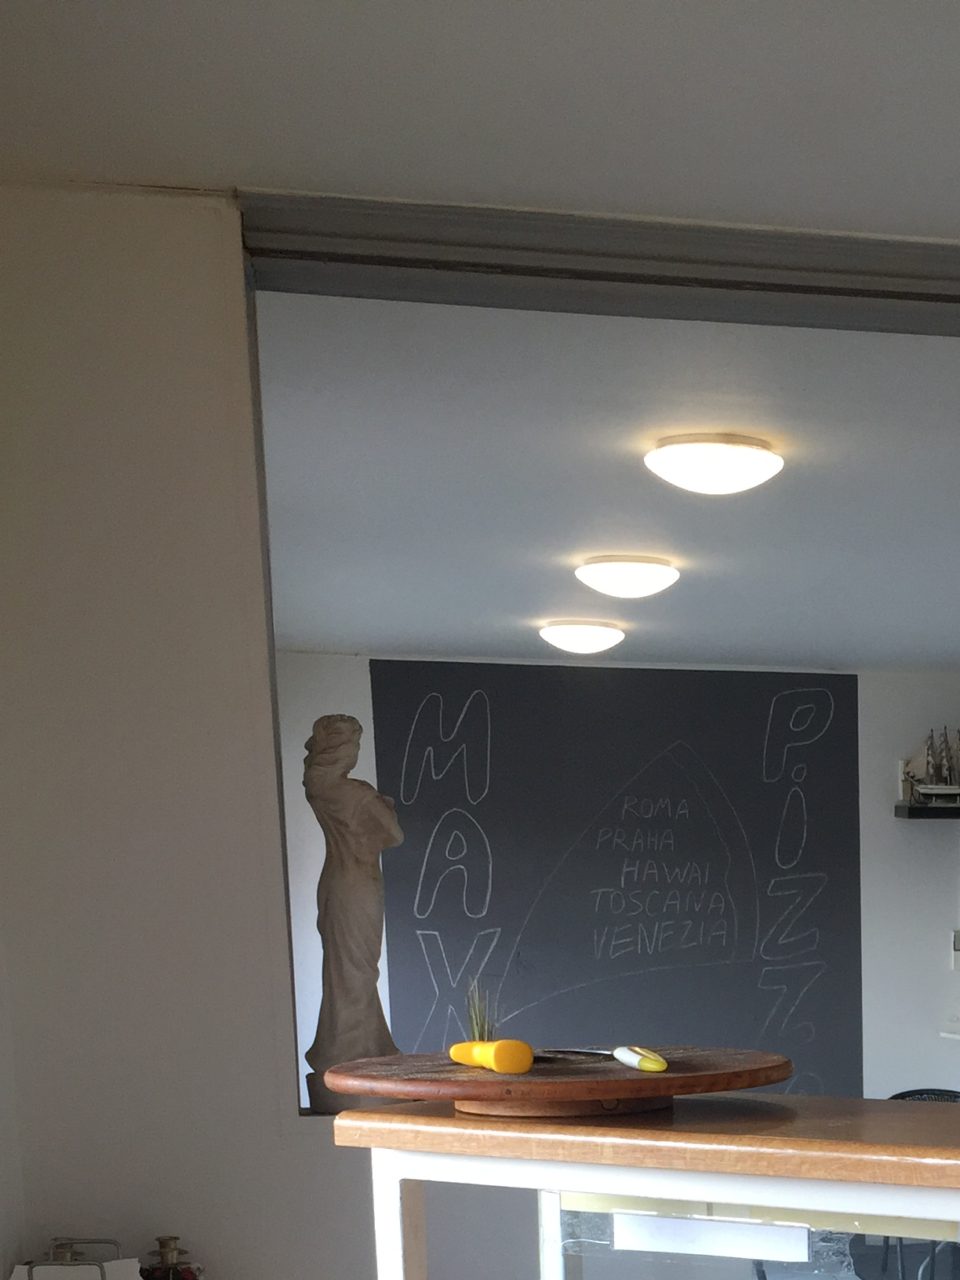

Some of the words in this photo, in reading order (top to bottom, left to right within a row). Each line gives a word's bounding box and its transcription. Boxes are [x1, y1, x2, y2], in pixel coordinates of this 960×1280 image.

[622, 796, 689, 820] ROMA
[596, 828, 674, 852] PRAHA
[621, 858, 710, 888] HAWAI
[590, 888, 725, 916] TOSCANA
[593, 919, 727, 959] VENEZIA
